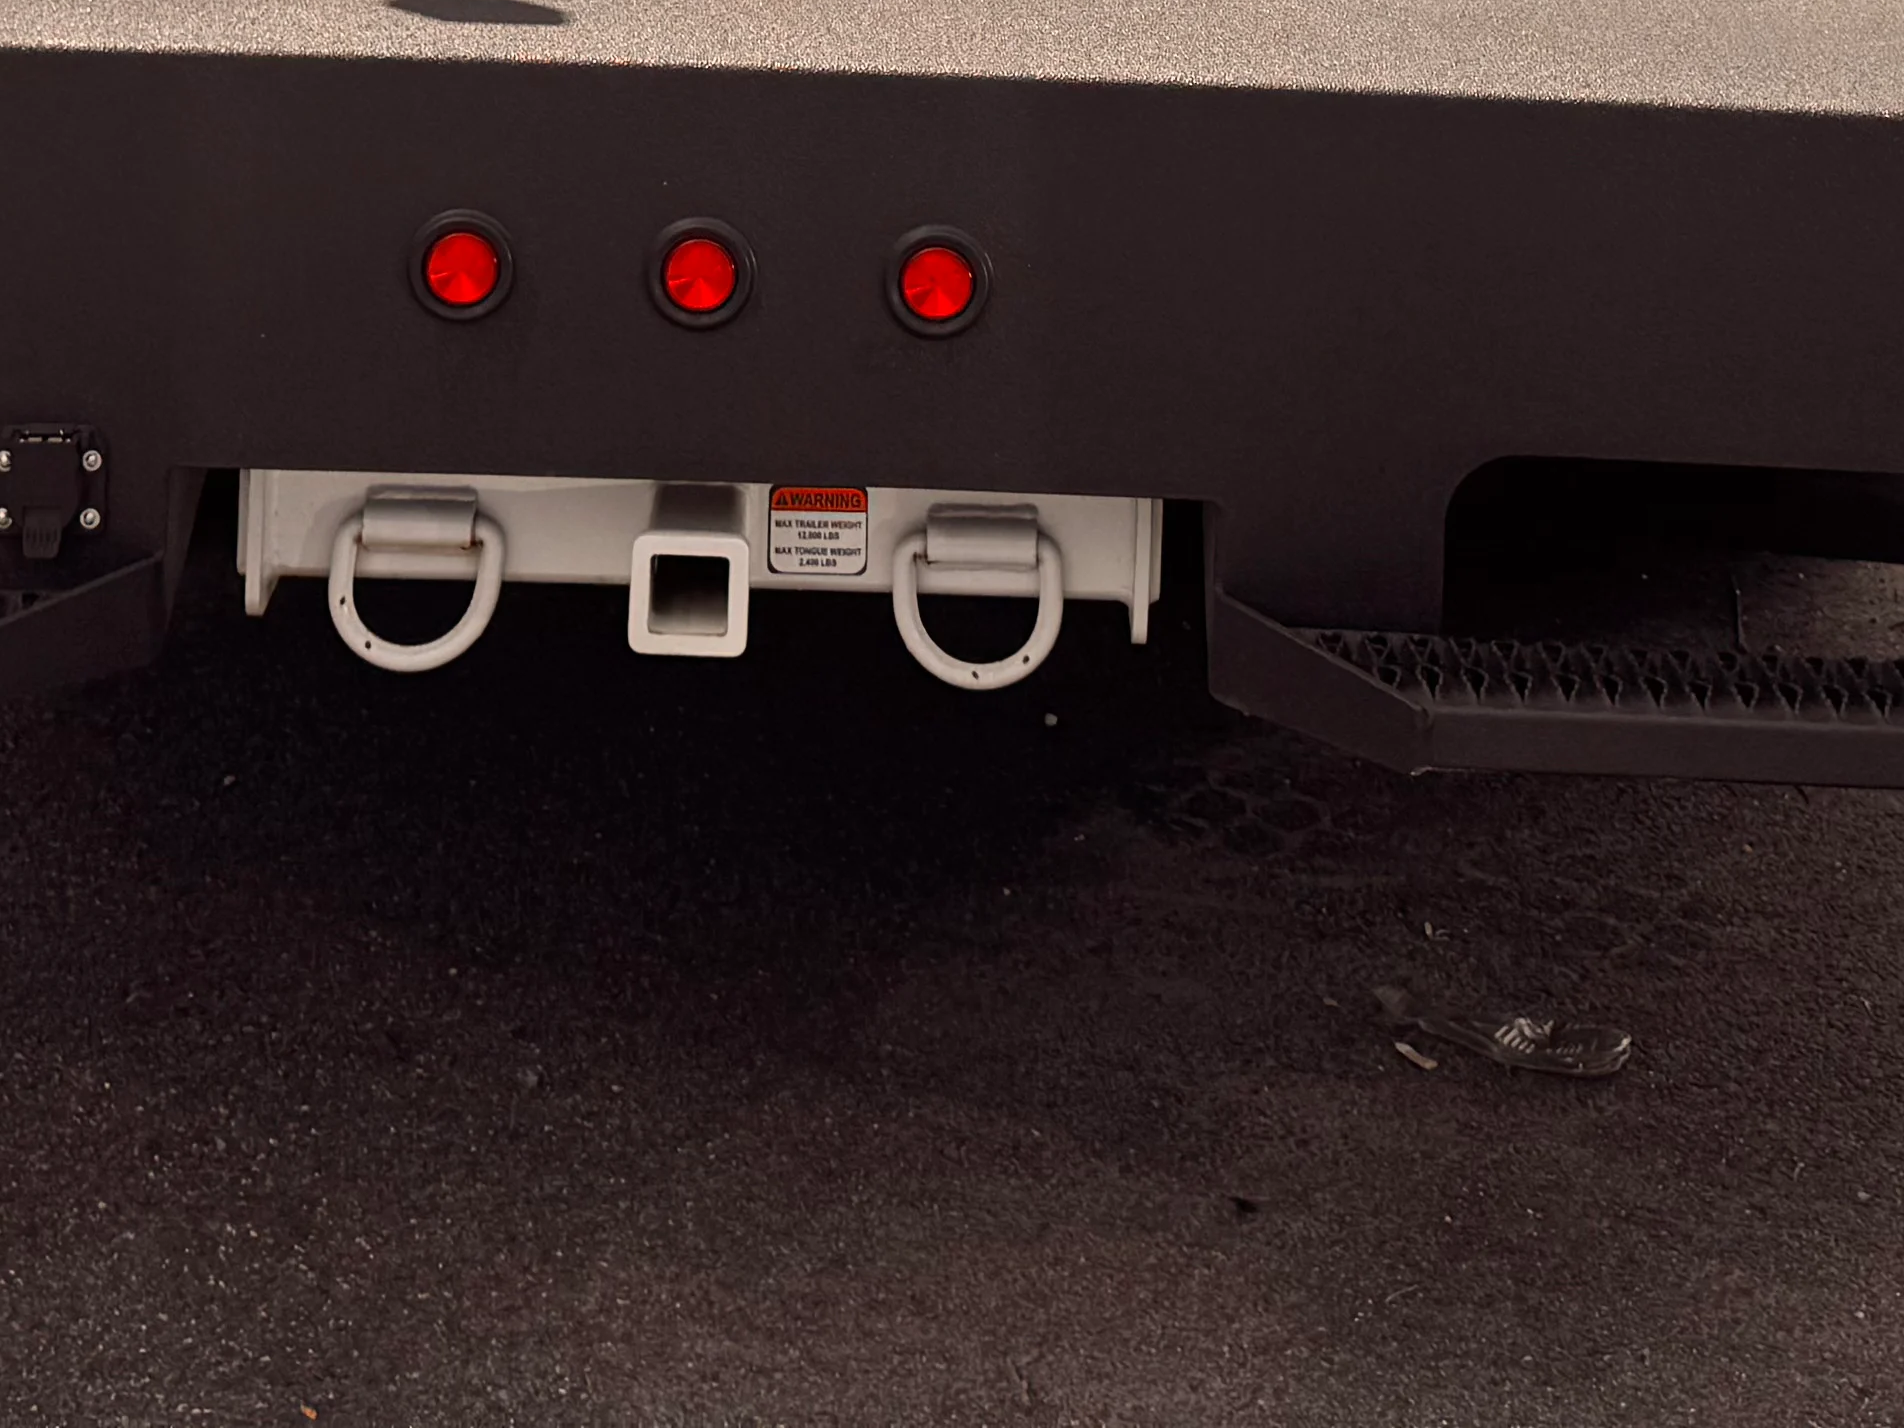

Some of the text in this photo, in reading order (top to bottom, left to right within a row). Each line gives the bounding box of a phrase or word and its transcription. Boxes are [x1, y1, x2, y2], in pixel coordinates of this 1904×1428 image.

[790, 493, 862, 509] WARNING
[775, 519, 862, 530] MAX TRAILER WEIGHT
[823, 531, 840, 540] LBS
[775, 547, 862, 556] MAX TONGUE WEIGHT
